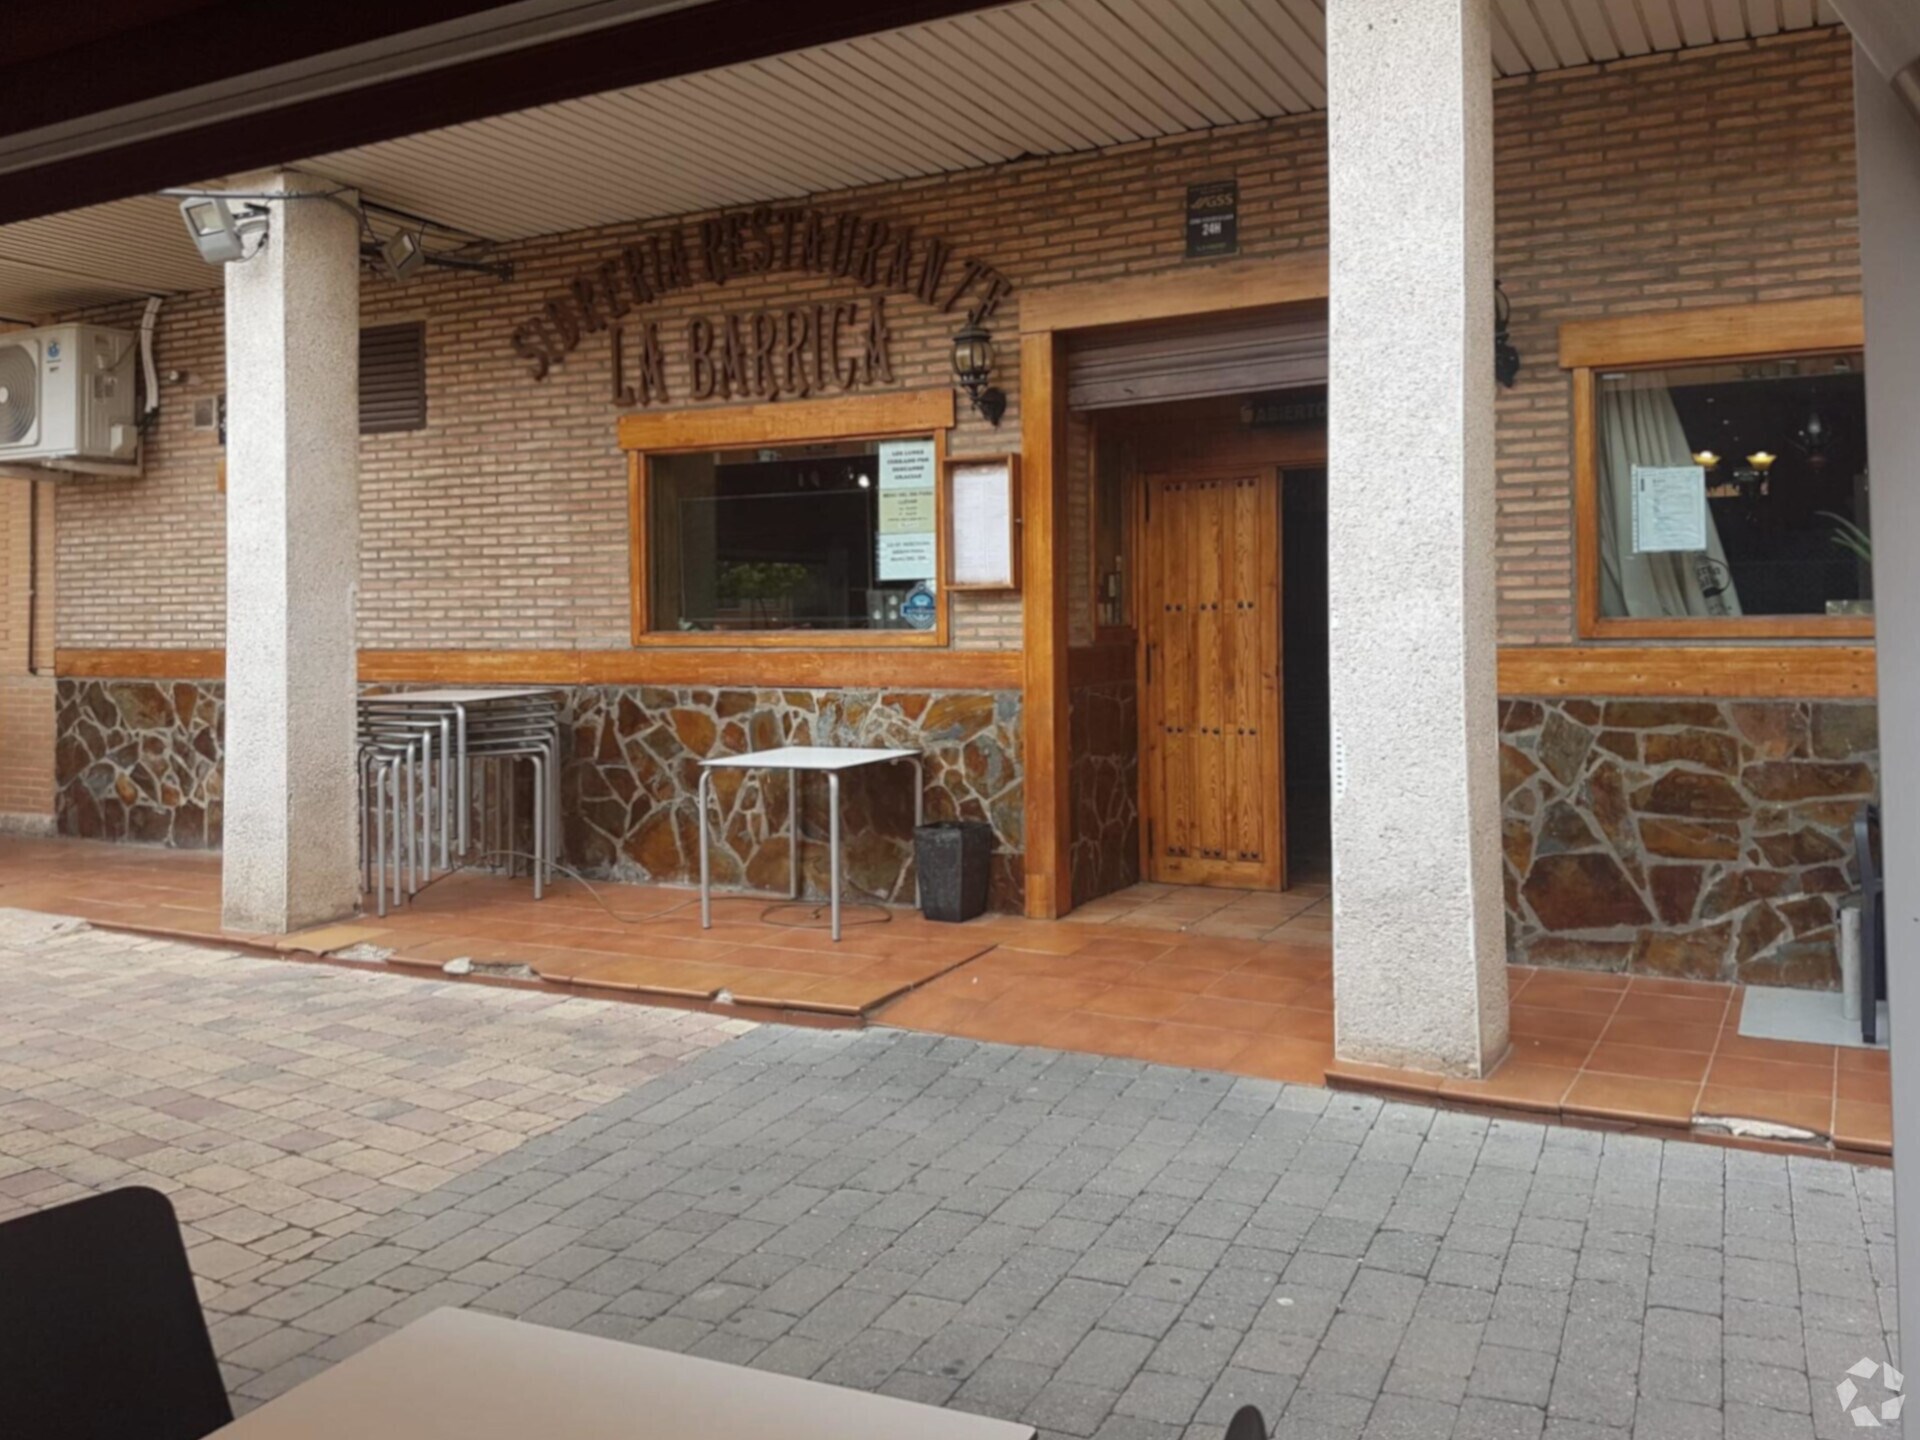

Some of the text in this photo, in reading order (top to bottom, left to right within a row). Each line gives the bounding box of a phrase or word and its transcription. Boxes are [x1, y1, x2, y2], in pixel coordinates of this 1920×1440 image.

[699, 204, 1014, 324] RESTAURANTE
[610, 297, 894, 408] LA BARRICA
